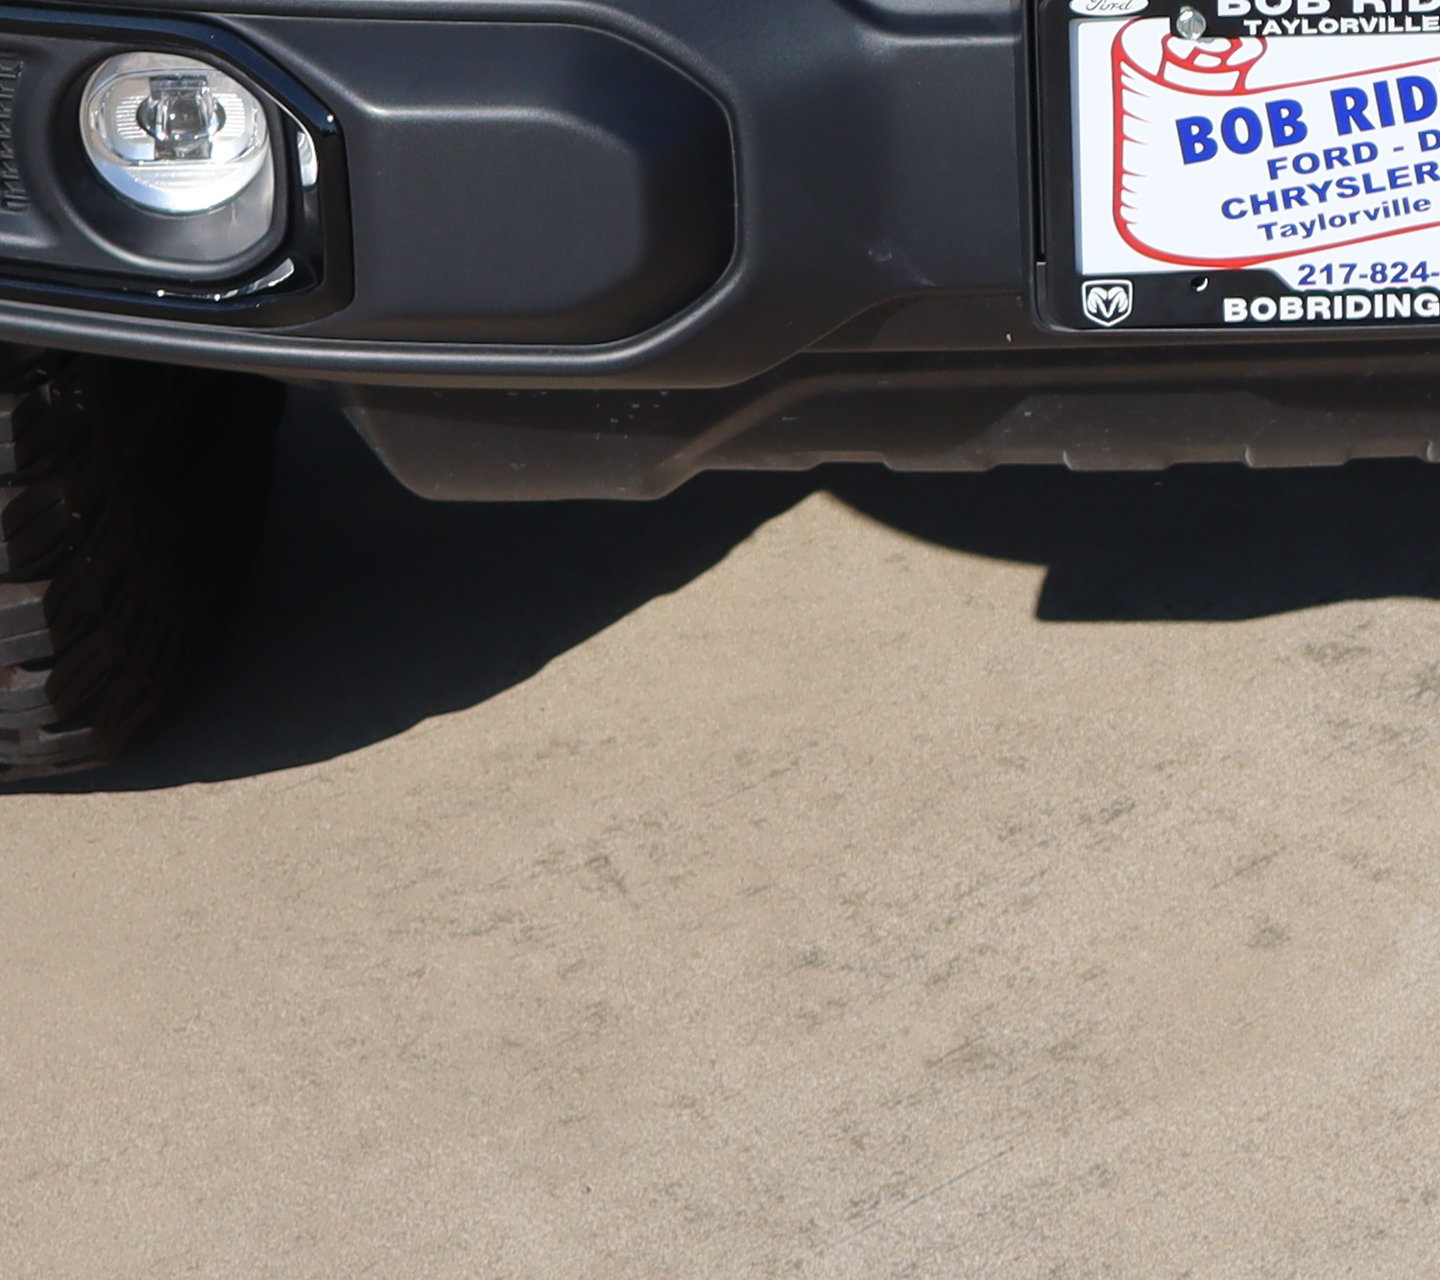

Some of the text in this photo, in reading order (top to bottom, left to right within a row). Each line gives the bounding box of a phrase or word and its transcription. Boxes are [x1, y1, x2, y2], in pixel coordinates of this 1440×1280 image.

[1244, 16, 1440, 35] TAYLORVILLE
[1176, 100, 1310, 165] BOB
[1266, 142, 1379, 179] FORD
[1221, 162, 1440, 220] CHRYSLER
[1258, 193, 1432, 242] Taylorville
